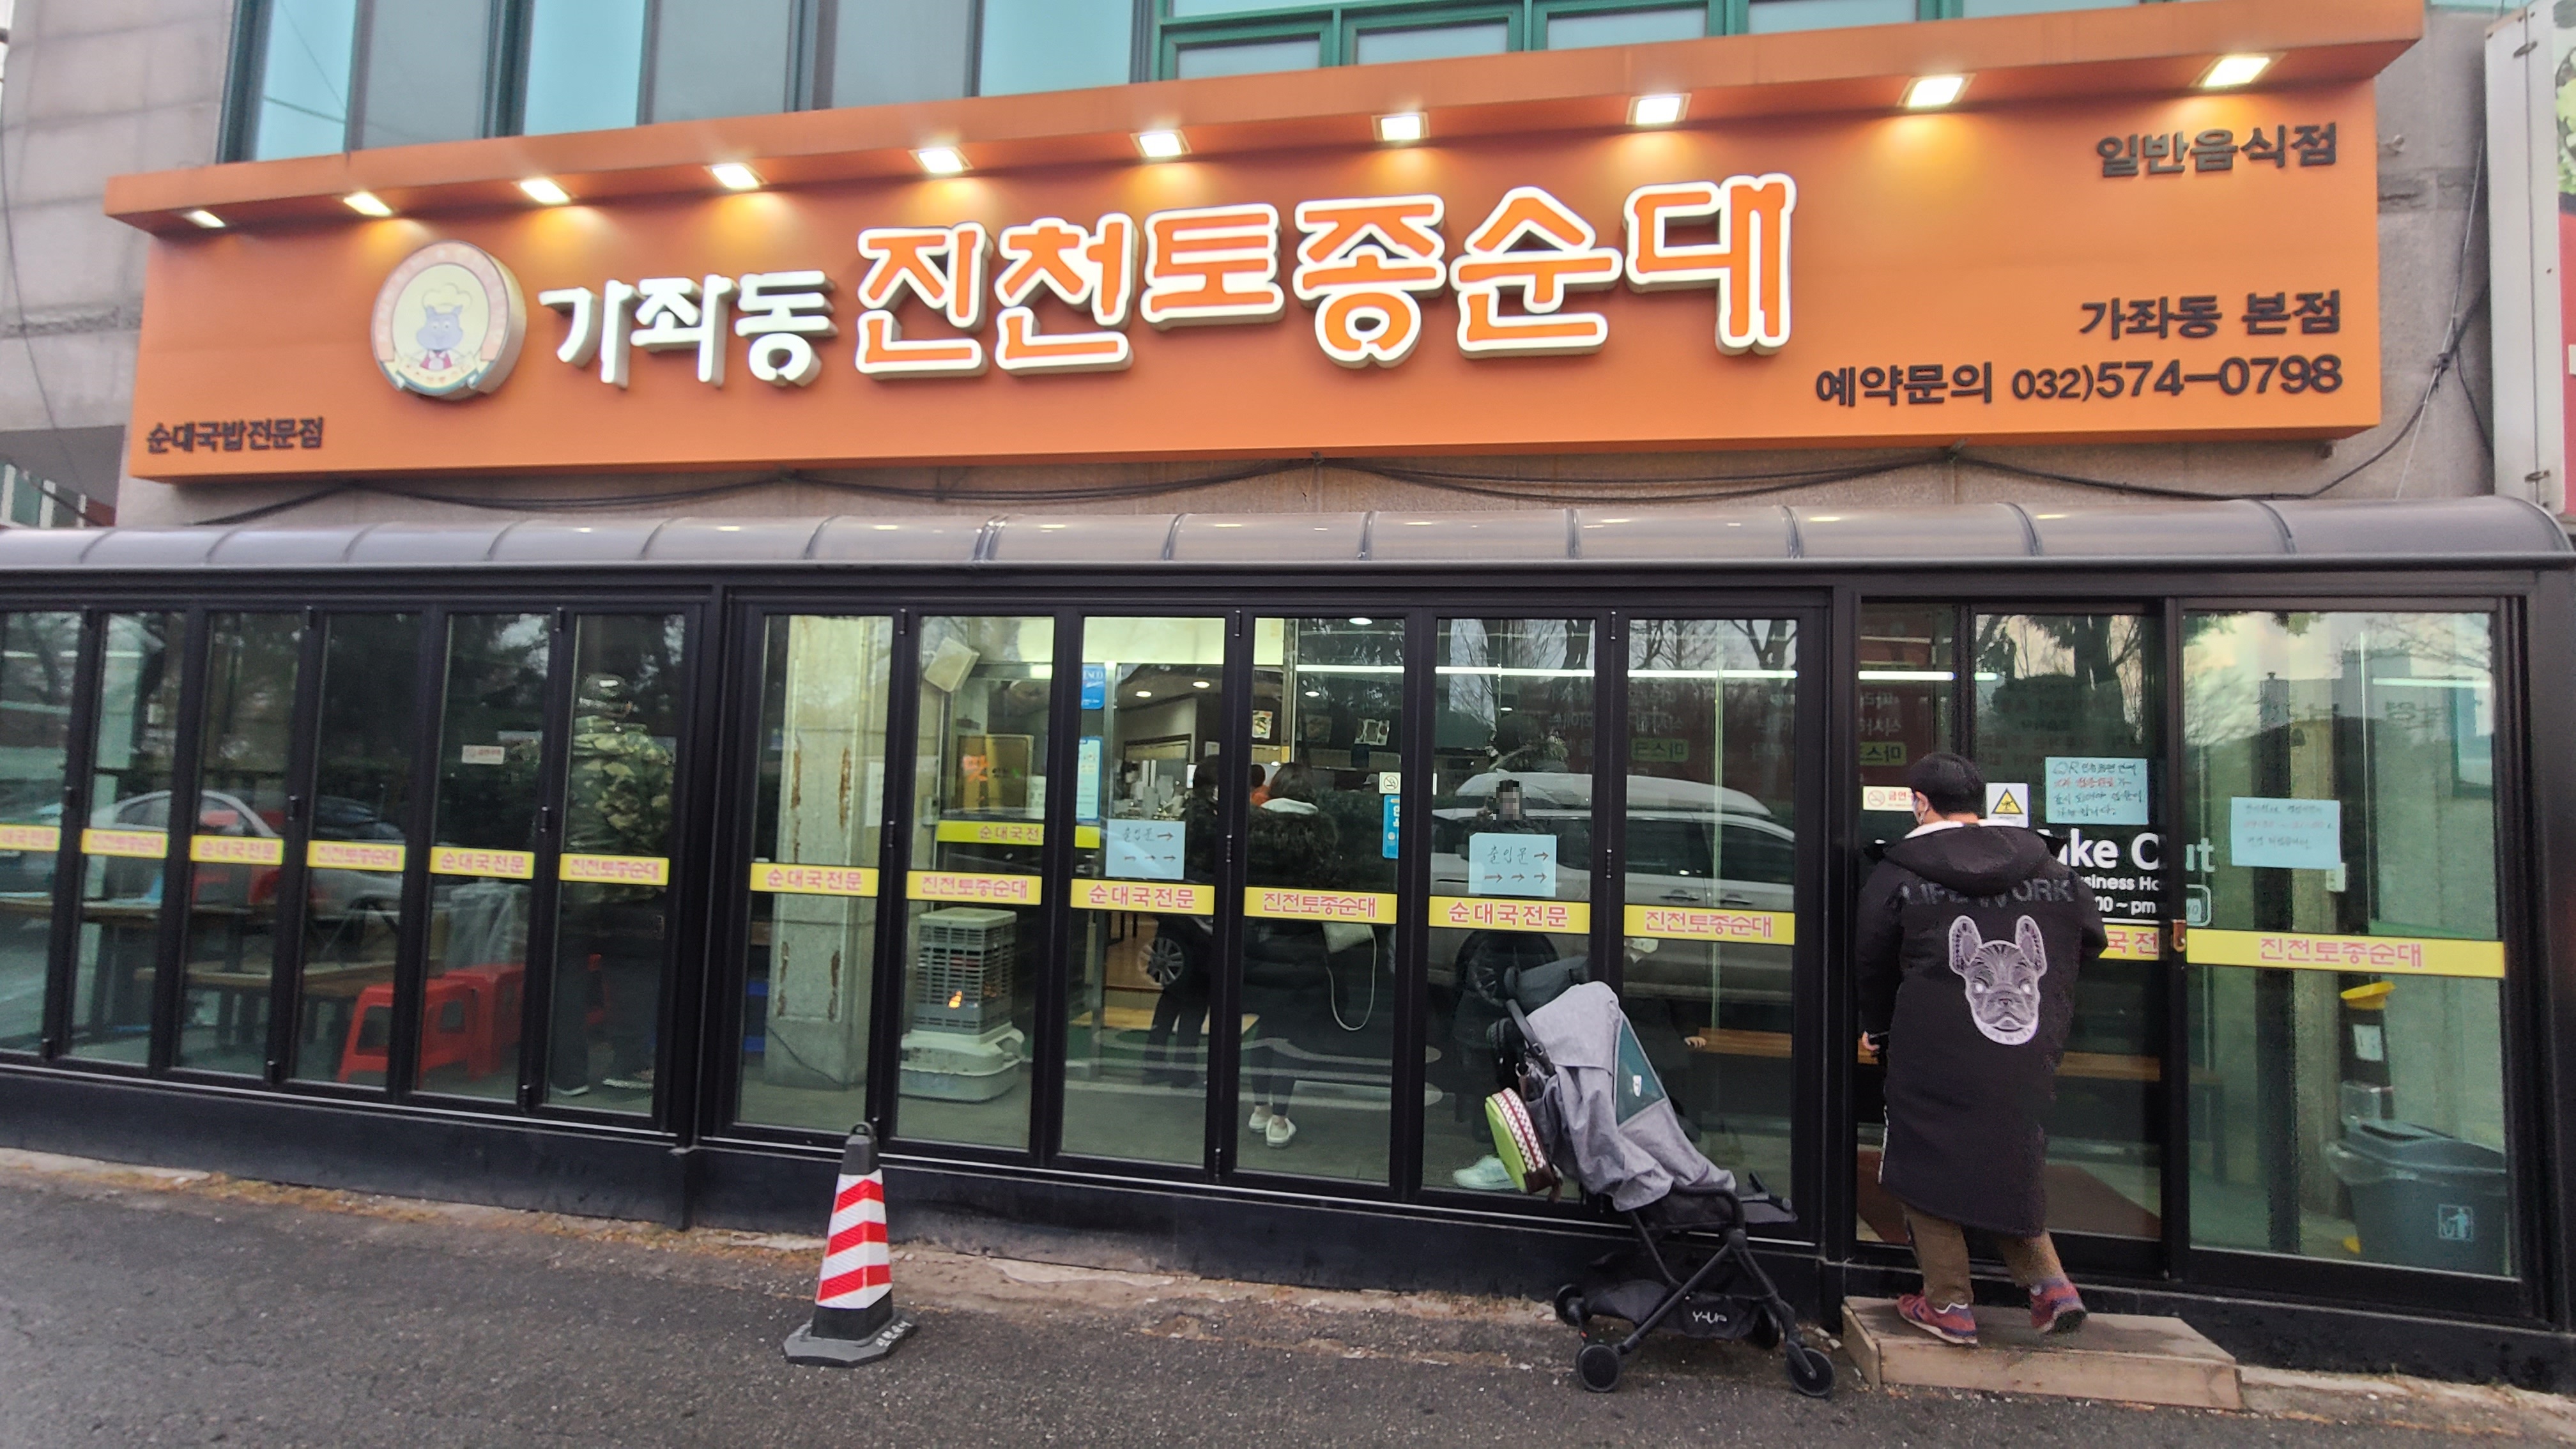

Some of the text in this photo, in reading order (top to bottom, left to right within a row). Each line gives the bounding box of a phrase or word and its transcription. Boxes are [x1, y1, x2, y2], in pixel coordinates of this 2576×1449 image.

[2096, 123, 2337, 178] 일반음식점
[538, 270, 837, 388] 가좌동
[856, 172, 1797, 376] 진천토종순대
[2079, 289, 2342, 341] 가좌동 본점
[1815, 353, 2343, 408] 예약문의 032)574-0798
[146, 416, 324, 454] 순대국밥전문점
[1888, 790, 1913, 802] 금연
[978, 825, 1043, 842] 순대국전
[440, 851, 526, 874] 순대국전문
[767, 868, 863, 891] 순대국전문
[922, 875, 1027, 900] 진천토종순대
[1088, 884, 1195, 909] 순대국전문
[1263, 892, 1377, 918] 진천토종순대
[2131, 900, 2157, 916] pm
[1448, 901, 1568, 928] 순대국전문
[1645, 910, 1772, 938] 진천토종순대
[2260, 937, 2422, 968] 진천토종순대
